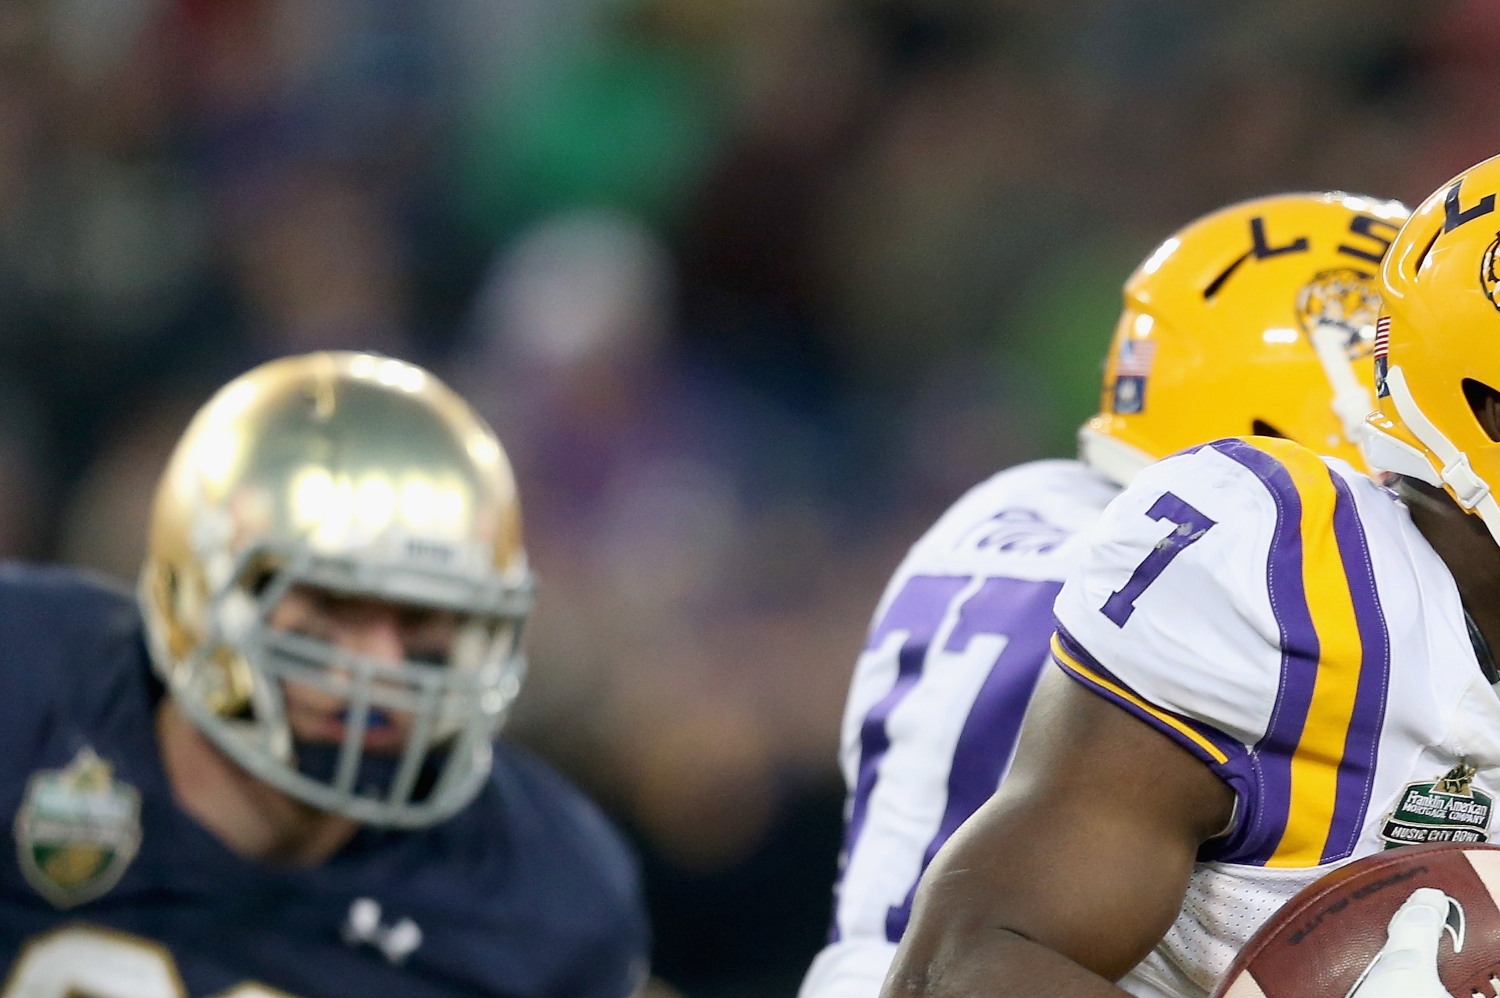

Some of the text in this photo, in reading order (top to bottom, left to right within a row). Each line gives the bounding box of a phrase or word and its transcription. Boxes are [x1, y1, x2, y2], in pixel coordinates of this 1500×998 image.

[1251, 211, 1402, 263] LS
[1100, 490, 1218, 629] 7
[828, 574, 1067, 942] 77
[1402, 803, 1486, 825] MORTGAGE COMPANY
[1406, 790, 1488, 817] Franklin American
[1391, 826, 1428, 841] MUSIC
[1427, 829, 1453, 841] CITY
